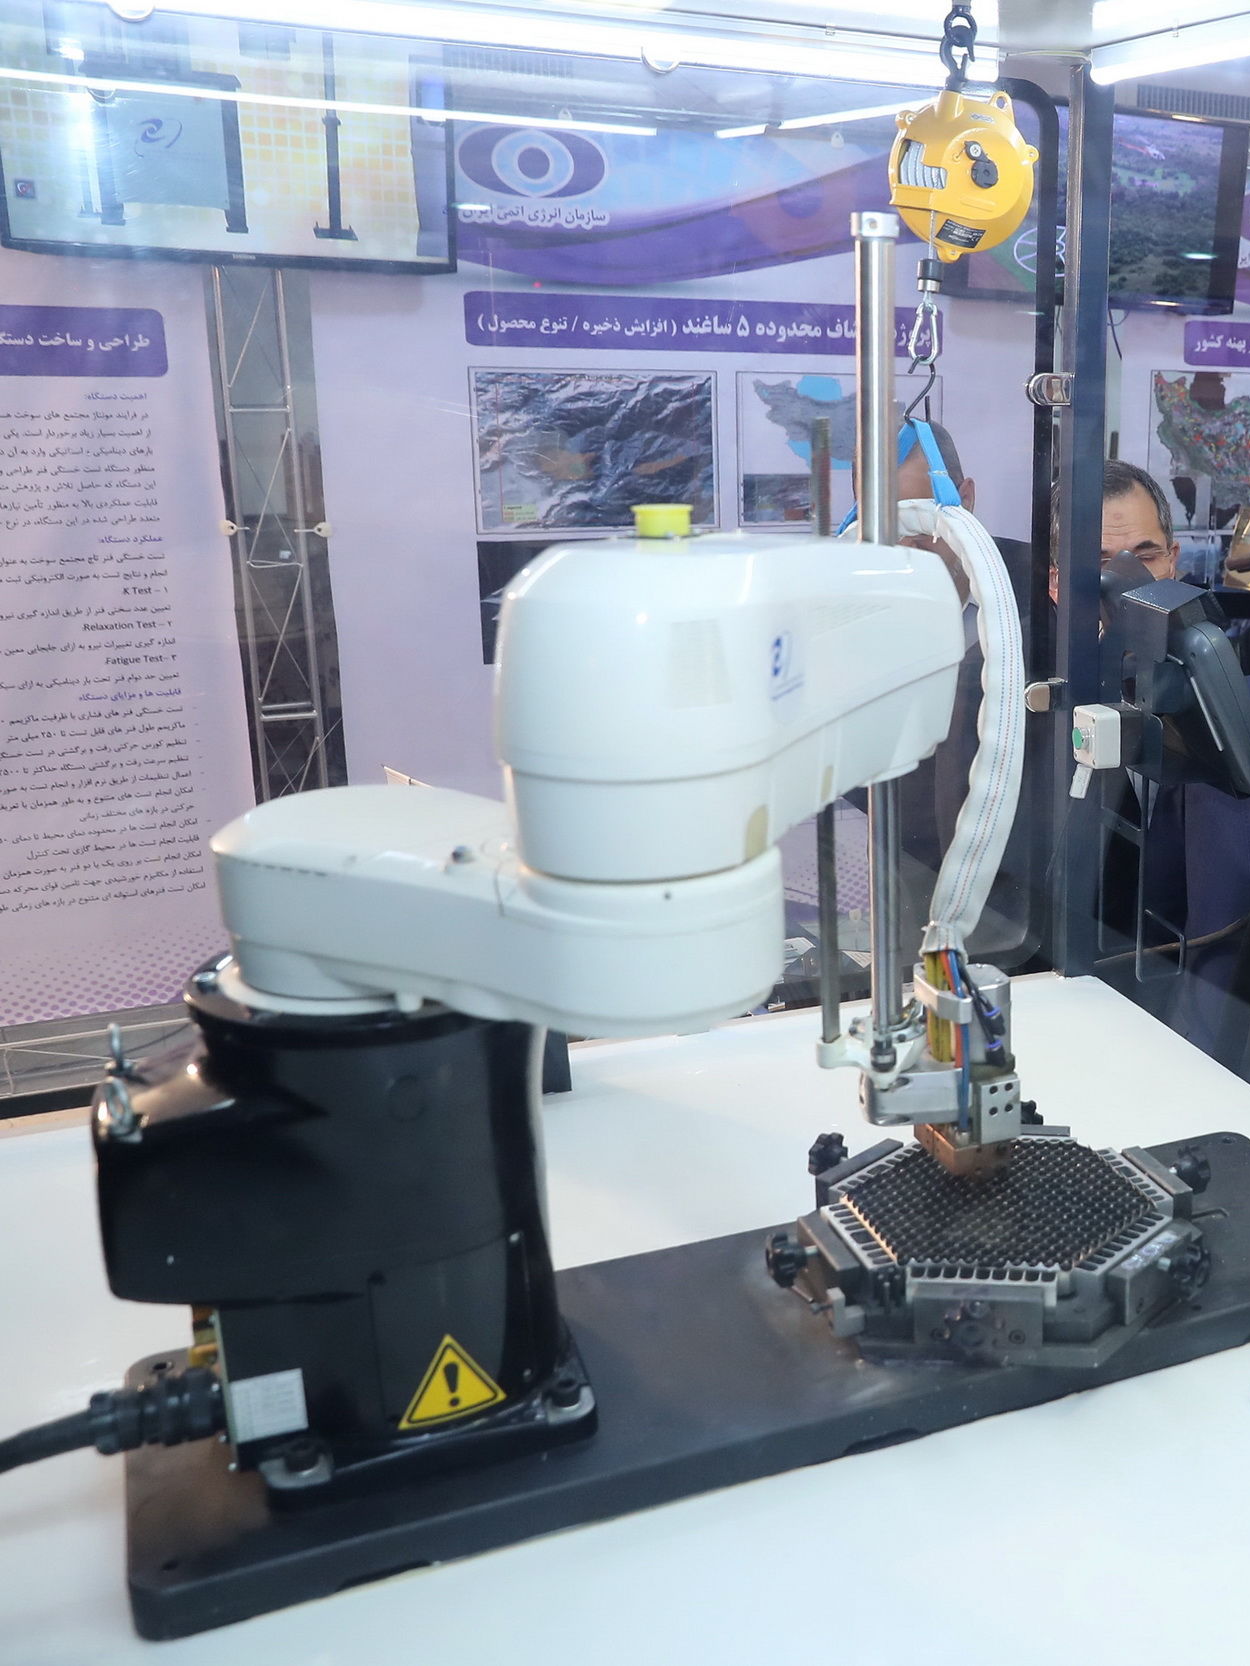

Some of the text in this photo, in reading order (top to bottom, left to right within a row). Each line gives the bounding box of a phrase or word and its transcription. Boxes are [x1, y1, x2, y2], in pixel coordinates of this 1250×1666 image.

[497, 206, 524, 220] اتمی
[528, 208, 561, 223] انرژی
[565, 209, 605, 224] سازمان
[1240, 252, 1250, 264] ایر
[488, 314, 536, 333] محصول
[540, 316, 568, 334] تنوع
[583, 318, 620, 335] ذخیره
[625, 317, 668, 336] افزایش
[682, 315, 730, 338] ساغند
[736, 315, 749, 336] ۵
[756, 321, 822, 342] محدوده
[38, 332, 82, 346] ساخت
[86, 338, 95, 351] و
[99, 334, 150, 351] طراحی
[1194, 335, 1224, 352] کشور
[1226, 338, 1246, 354] پهنه
[133, 586, 152, 594] Test
[136, 620, 156, 629] Test
[79, 693, 107, 701] دستگاه
